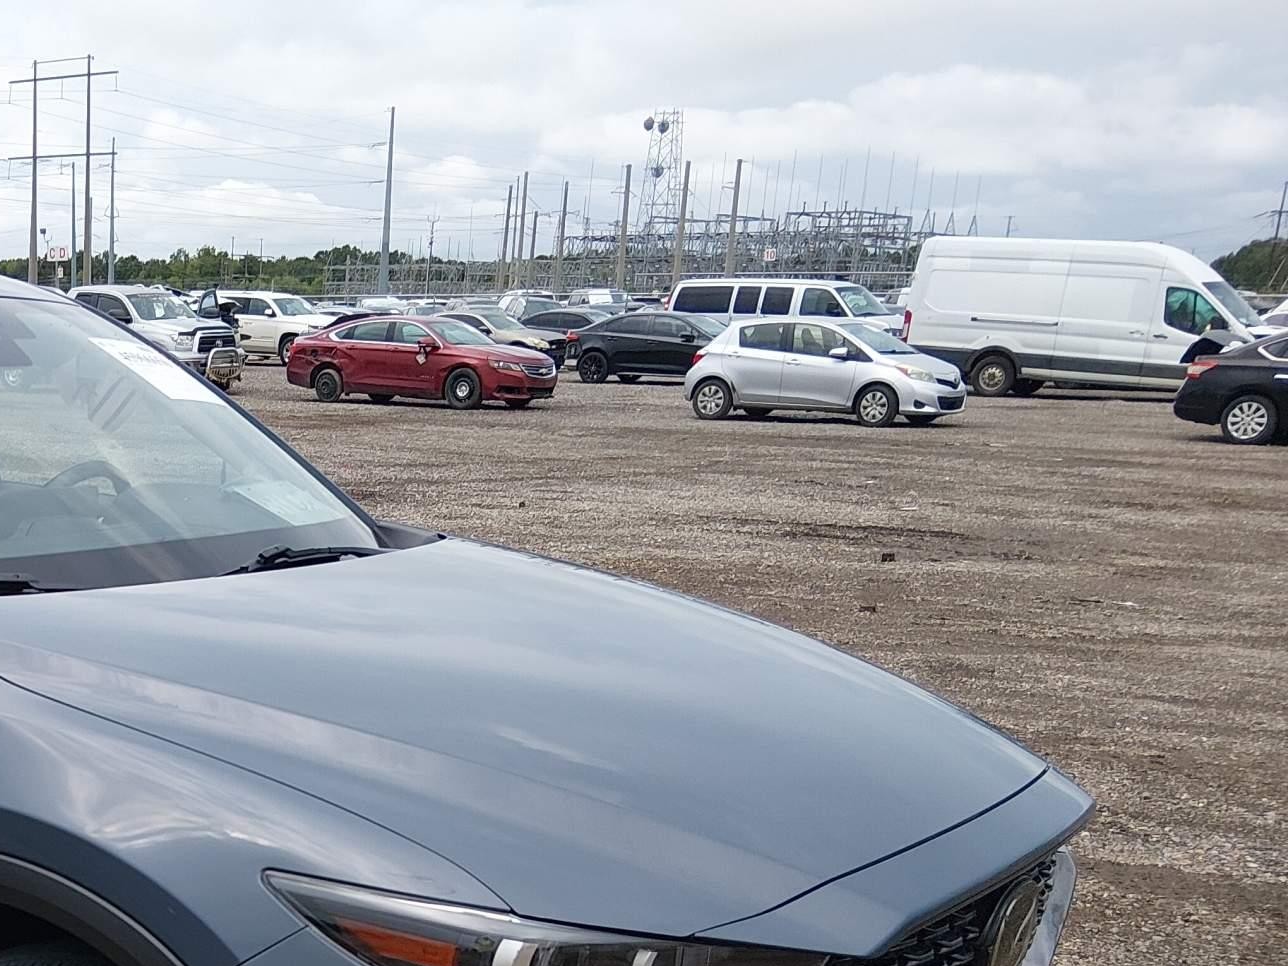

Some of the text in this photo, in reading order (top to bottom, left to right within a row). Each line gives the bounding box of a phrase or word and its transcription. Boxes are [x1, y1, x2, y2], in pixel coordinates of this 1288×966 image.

[49, 247, 66, 259] C D
[766, 250, 775, 260] 10
